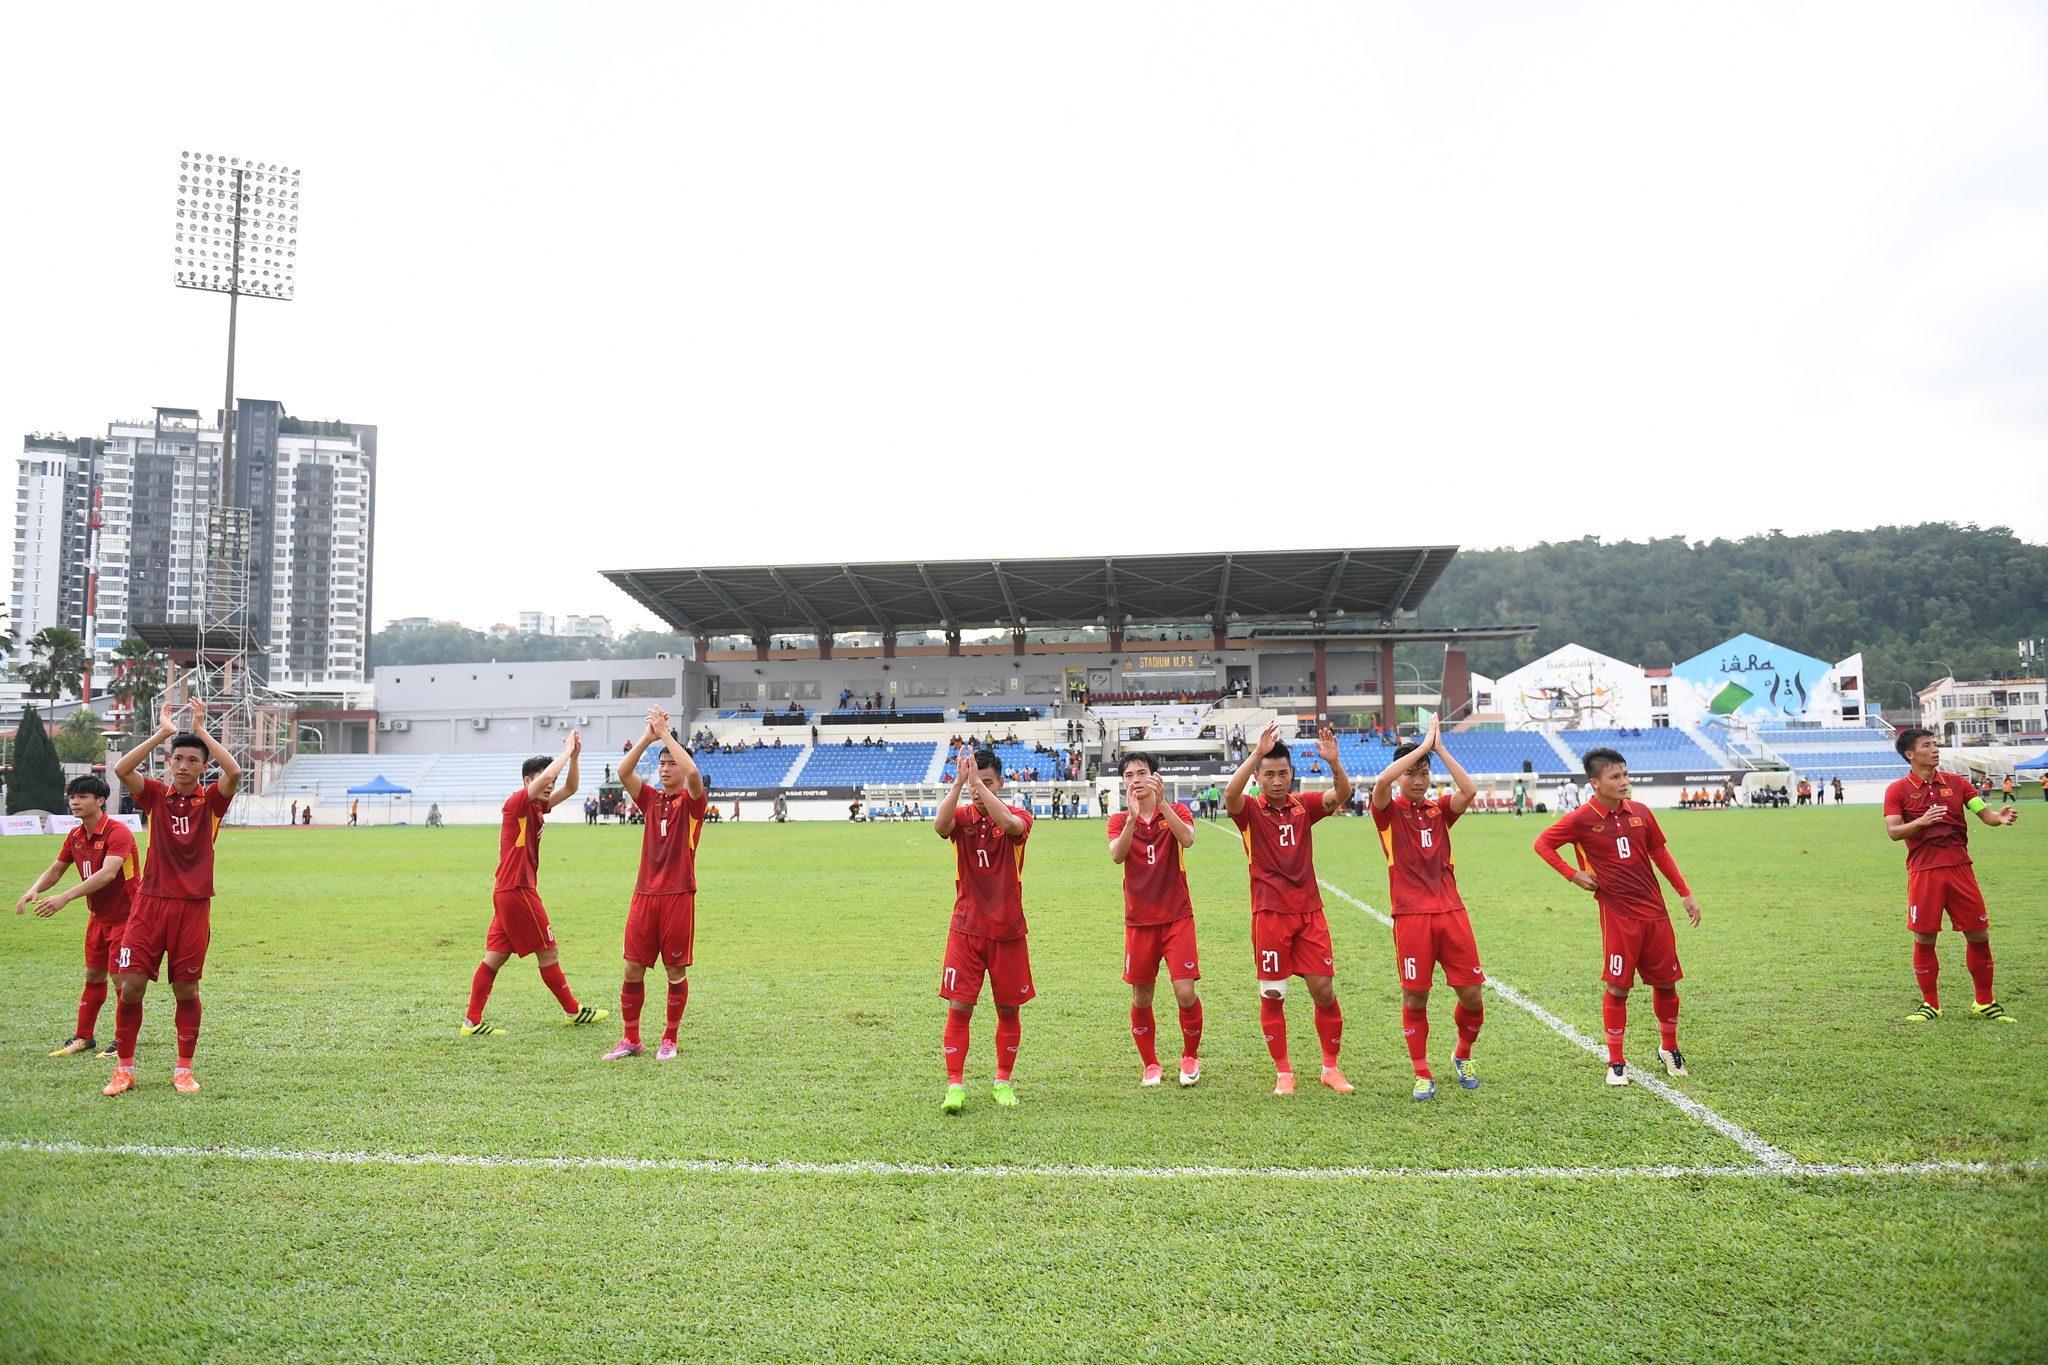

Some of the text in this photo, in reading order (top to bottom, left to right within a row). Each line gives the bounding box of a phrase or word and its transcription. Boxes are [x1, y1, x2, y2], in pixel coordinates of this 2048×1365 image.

[1139, 656, 1170, 669] STADIUM
[172, 815, 190, 835] 20
[1279, 824, 1295, 847] 27
[1420, 828, 1433, 848] 16
[1616, 836, 1631, 859] 19
[1147, 844, 1156, 865] 9
[82, 860, 92, 879] 10
[1910, 905, 1918, 924] 4
[546, 924, 554, 942] 6
[1261, 950, 1279, 973] 27
[1404, 957, 1417, 980] 16
[1609, 953, 1623, 976] 19
[944, 966, 957, 991] 17
